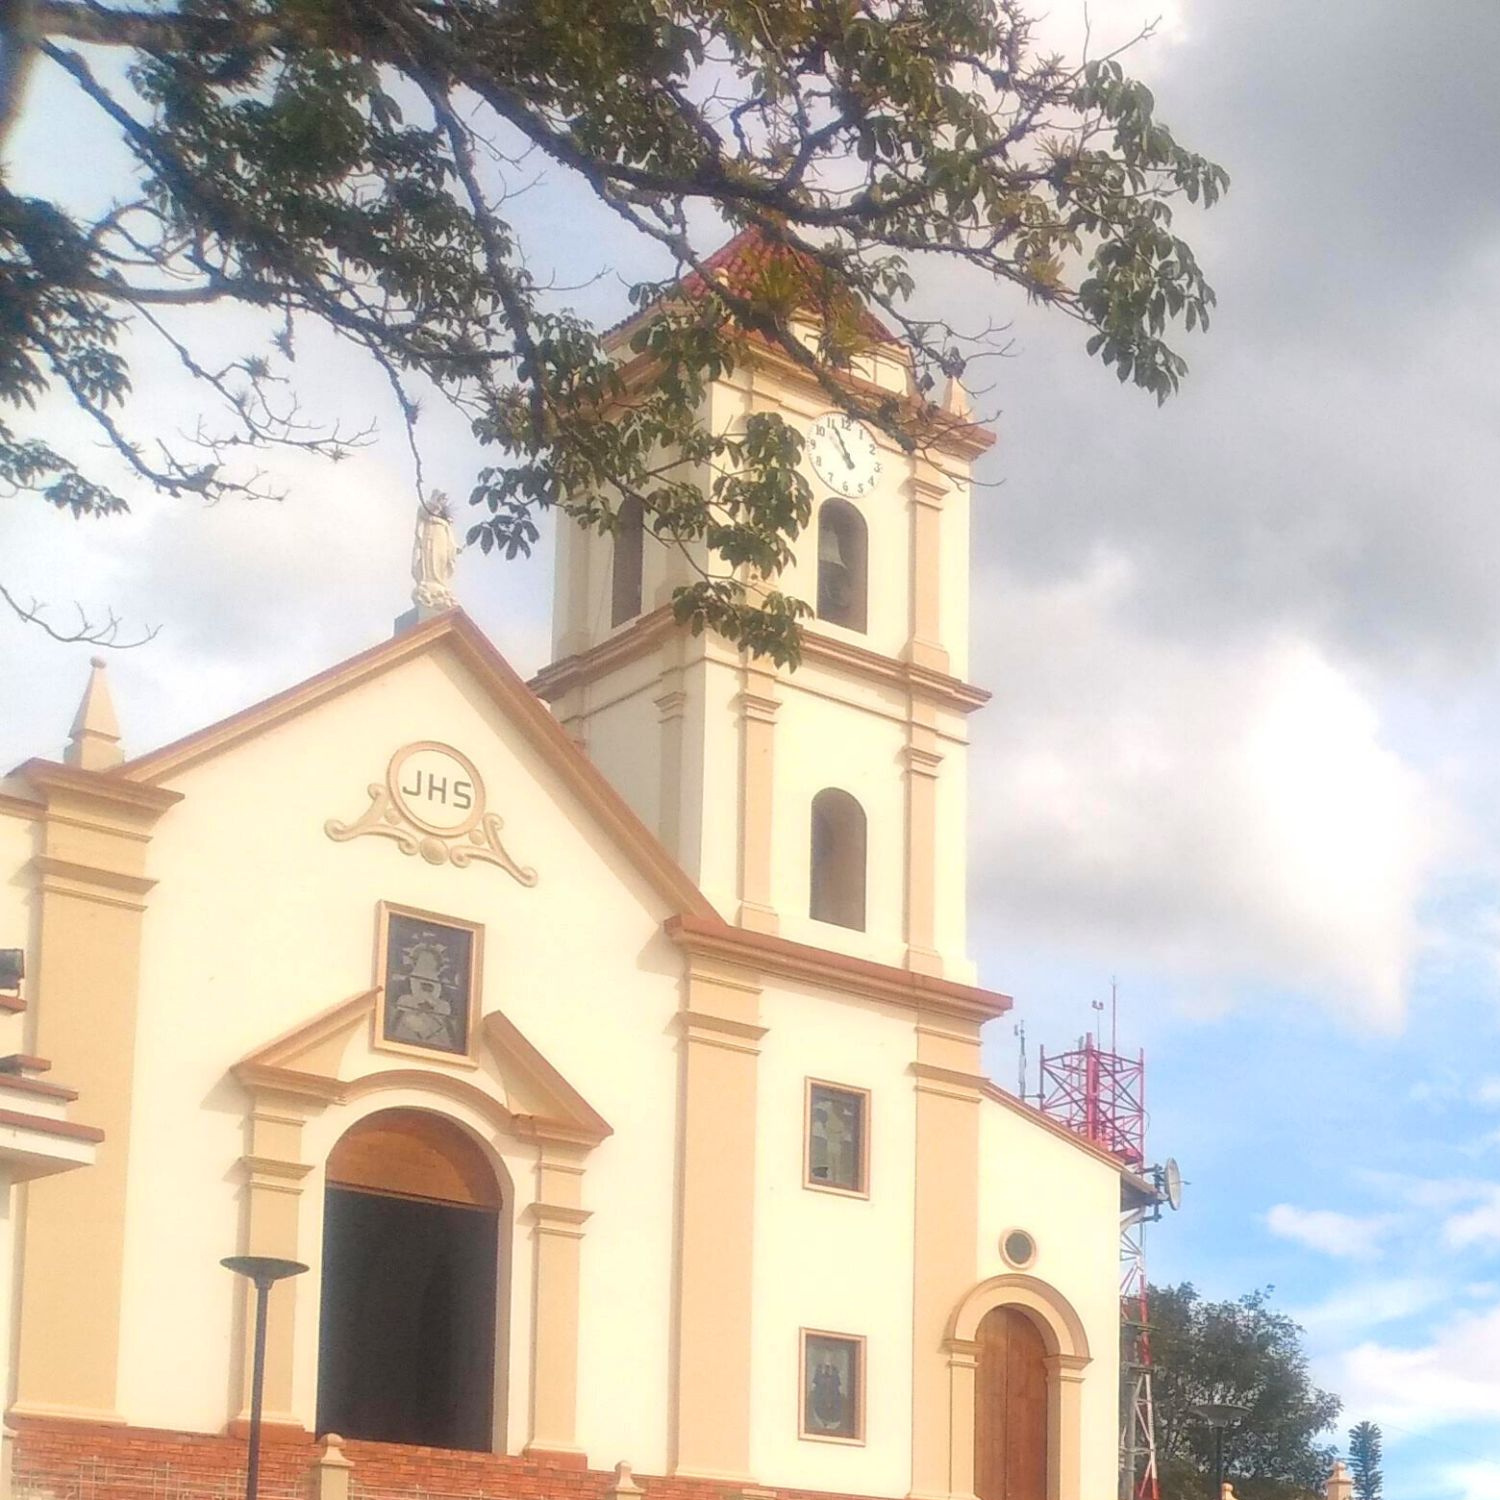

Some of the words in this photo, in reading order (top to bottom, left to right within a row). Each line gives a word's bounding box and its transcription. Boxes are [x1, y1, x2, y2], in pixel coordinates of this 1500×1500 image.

[841, 417, 851, 431] 12
[816, 424, 825, 437] 10
[810, 439, 816, 449] 9
[869, 443, 876, 455] 2
[816, 455, 822, 467] 8
[873, 462, 881, 473] 3
[827, 471, 834, 483] 7
[868, 475, 874, 487] 4
[842, 480, 848, 492] 6
[857, 483, 863, 494] 5
[402, 770, 471, 810] JHS
